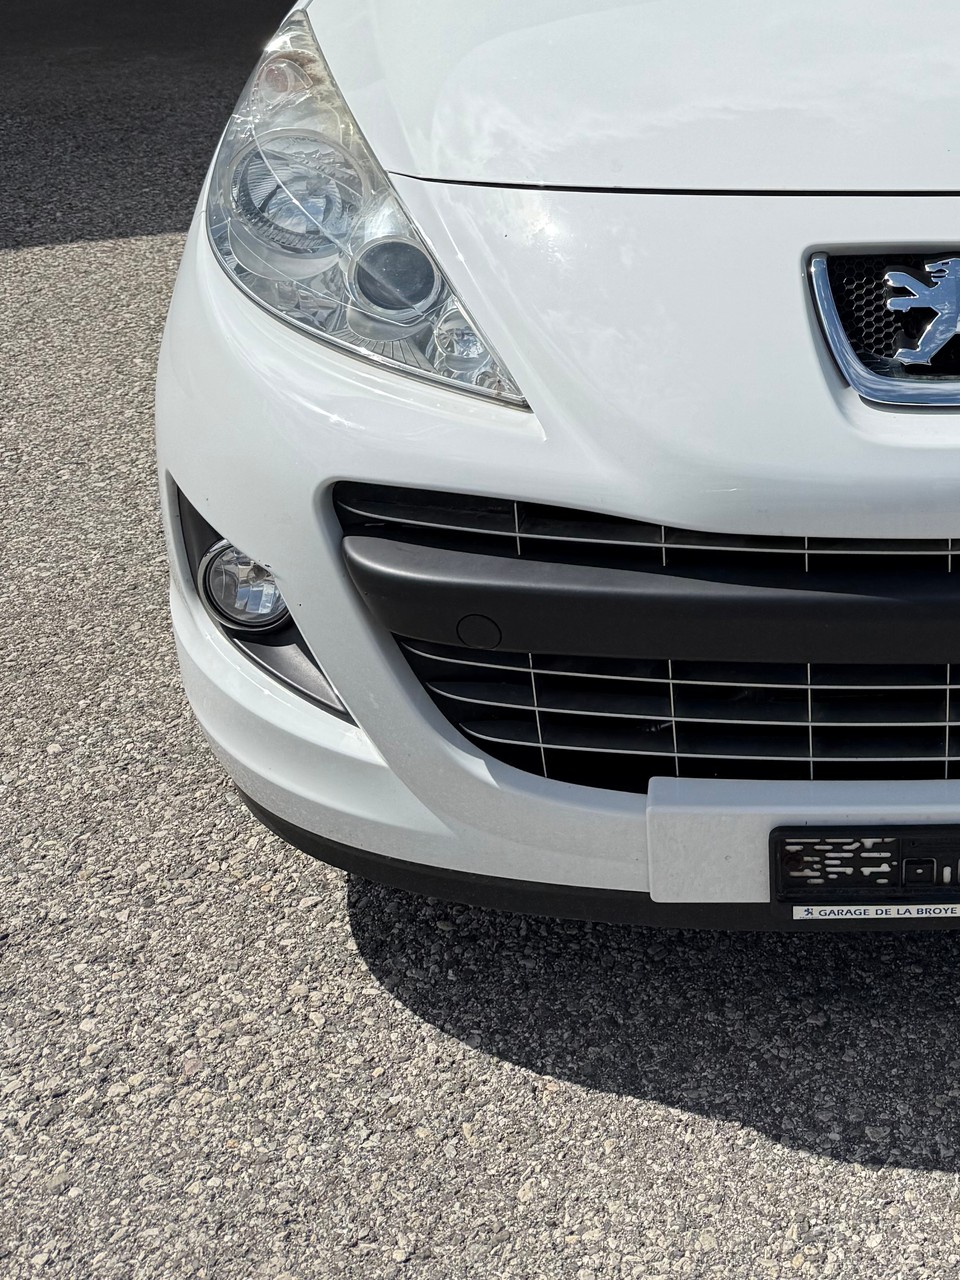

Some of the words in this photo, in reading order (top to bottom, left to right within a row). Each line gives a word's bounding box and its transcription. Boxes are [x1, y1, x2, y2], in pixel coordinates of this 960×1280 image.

[818, 907, 870, 917] GARAGE
[875, 907, 892, 916] DE
[896, 907, 914, 916] LA
[916, 906, 958, 916] BROYE
